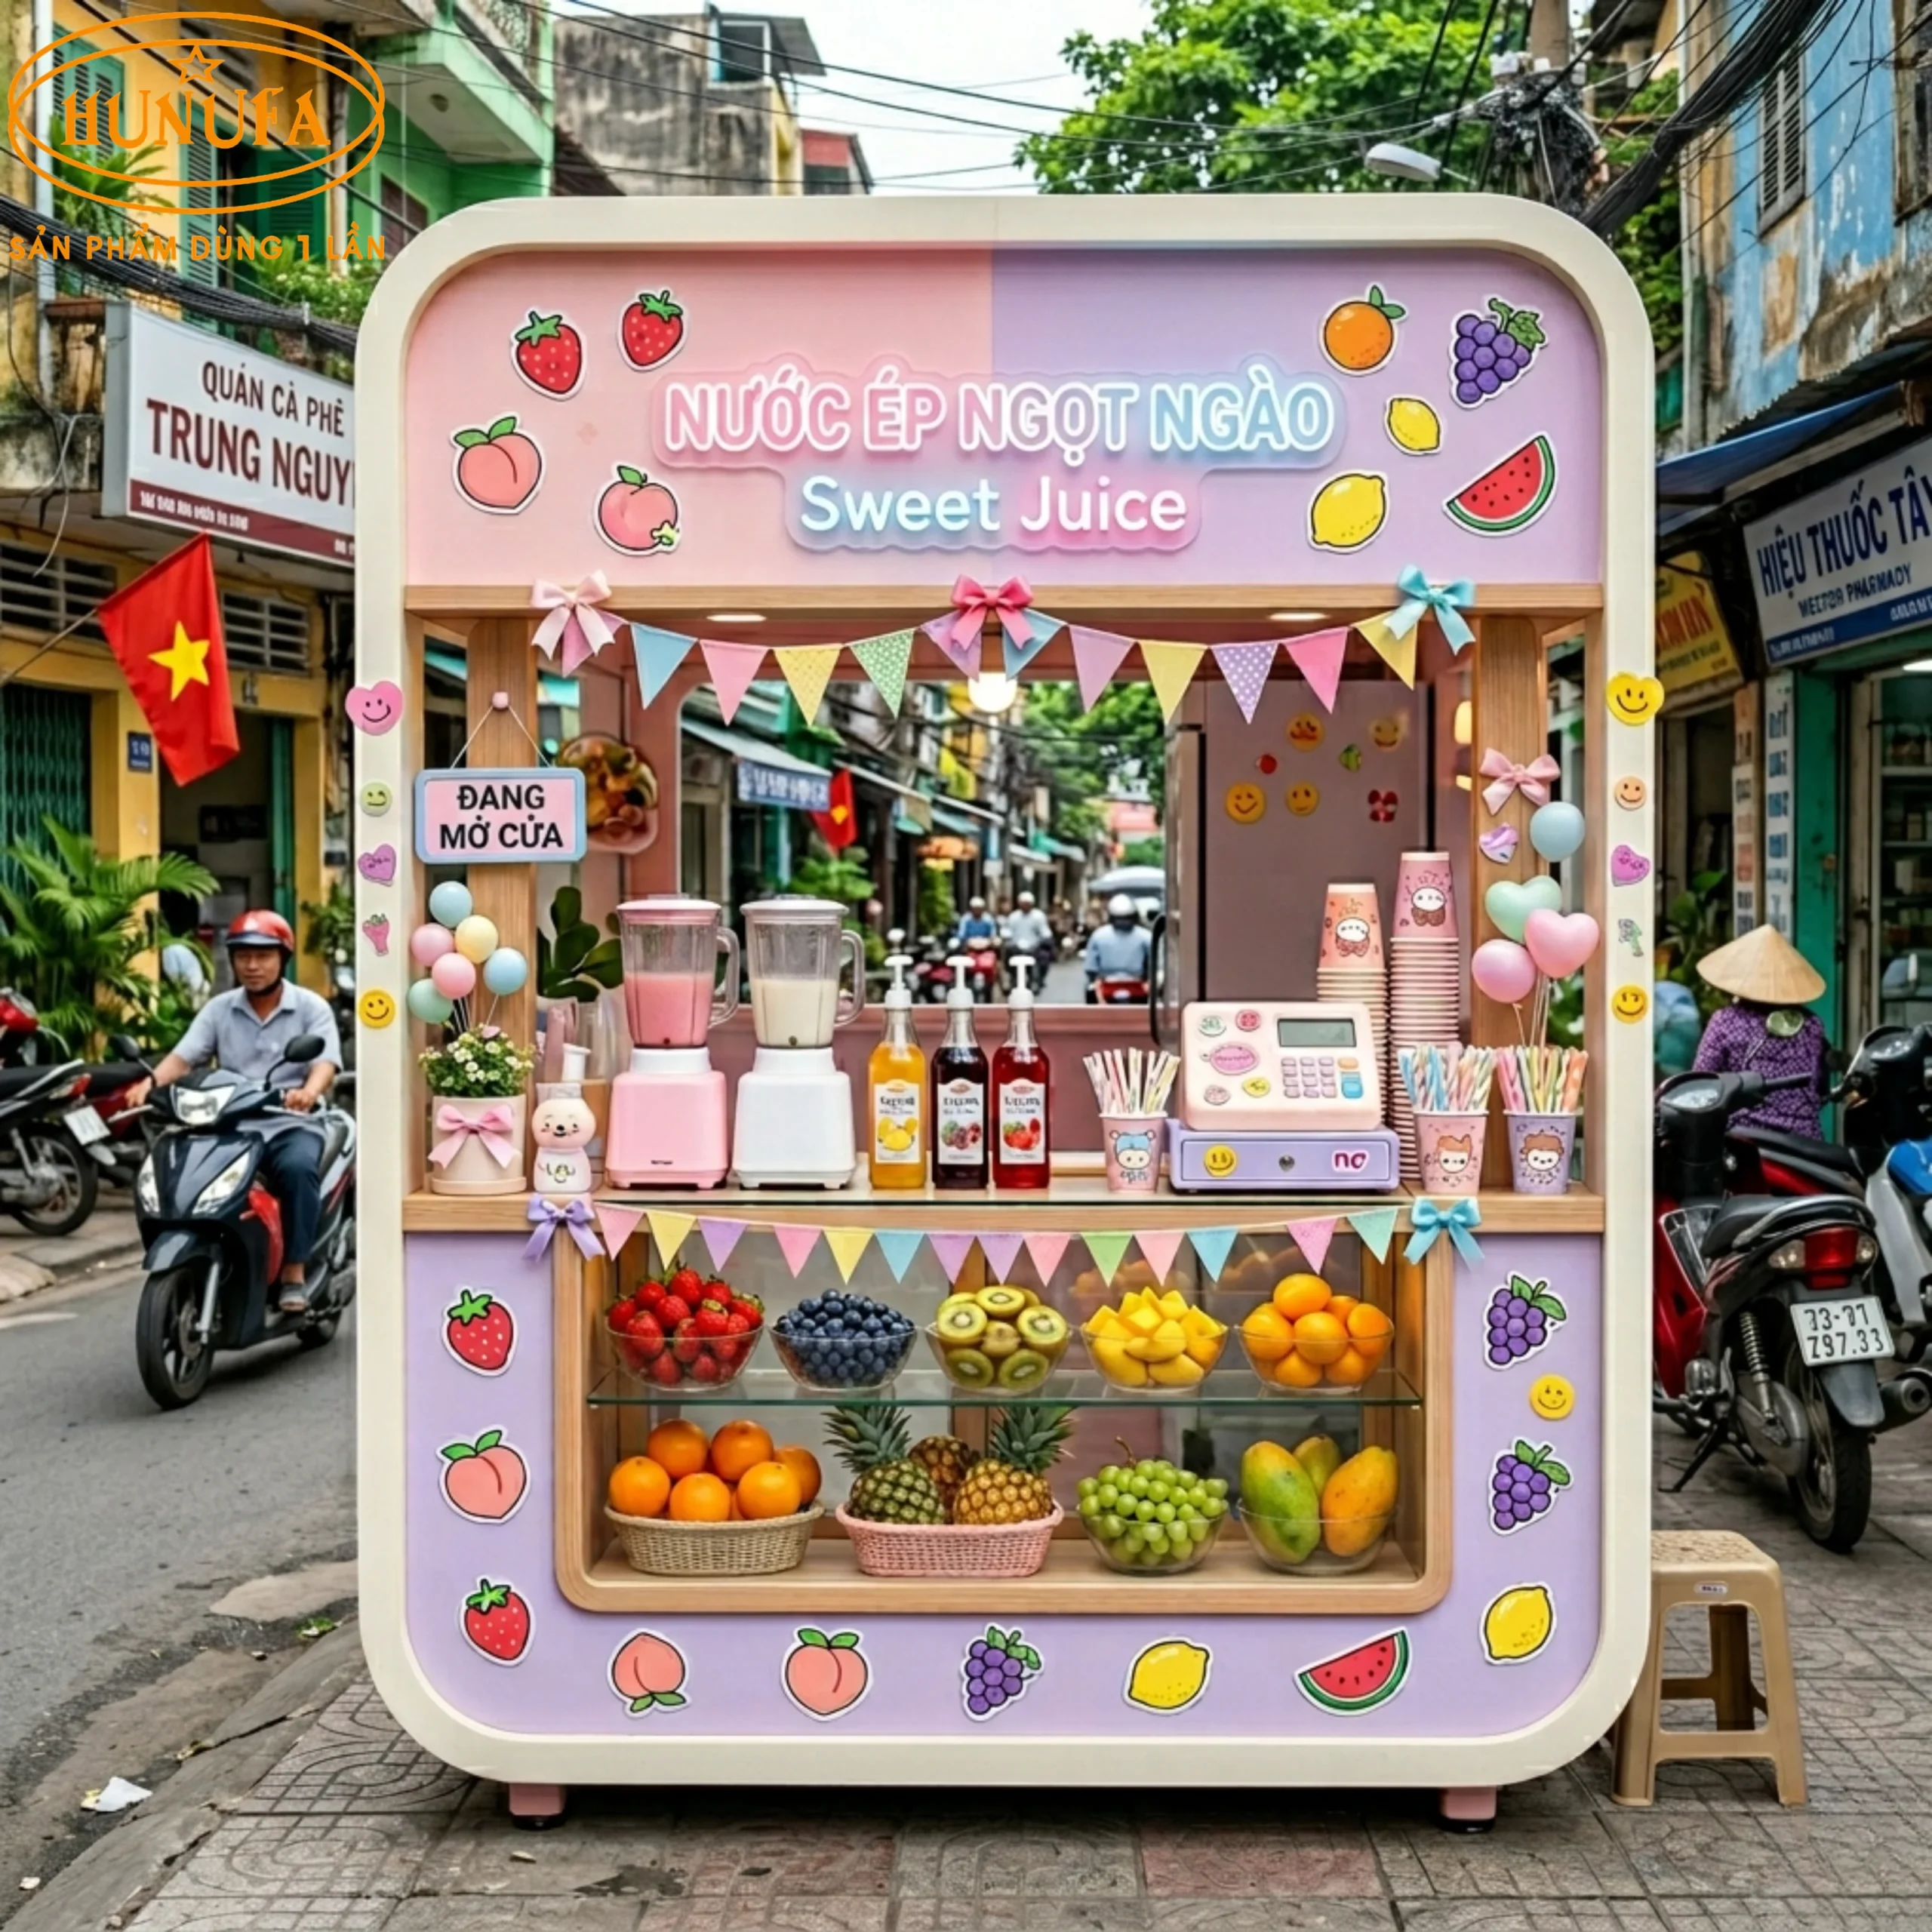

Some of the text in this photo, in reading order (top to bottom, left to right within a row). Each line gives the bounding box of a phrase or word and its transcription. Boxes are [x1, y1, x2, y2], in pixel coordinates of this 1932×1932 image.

[202, 361, 264, 411] QUÁN
[272, 380, 299, 423] CÀ
[663, 365, 1336, 466] NƯỚC ÉP NGỌT NGÀO
[146, 398, 355, 510] TRUNG NGUY
[800, 475, 1187, 533] Sweet Juice
[1757, 525, 1807, 599] HIỆU
[1807, 479, 1888, 577] THUỐC
[457, 783, 545, 811] ĐANG
